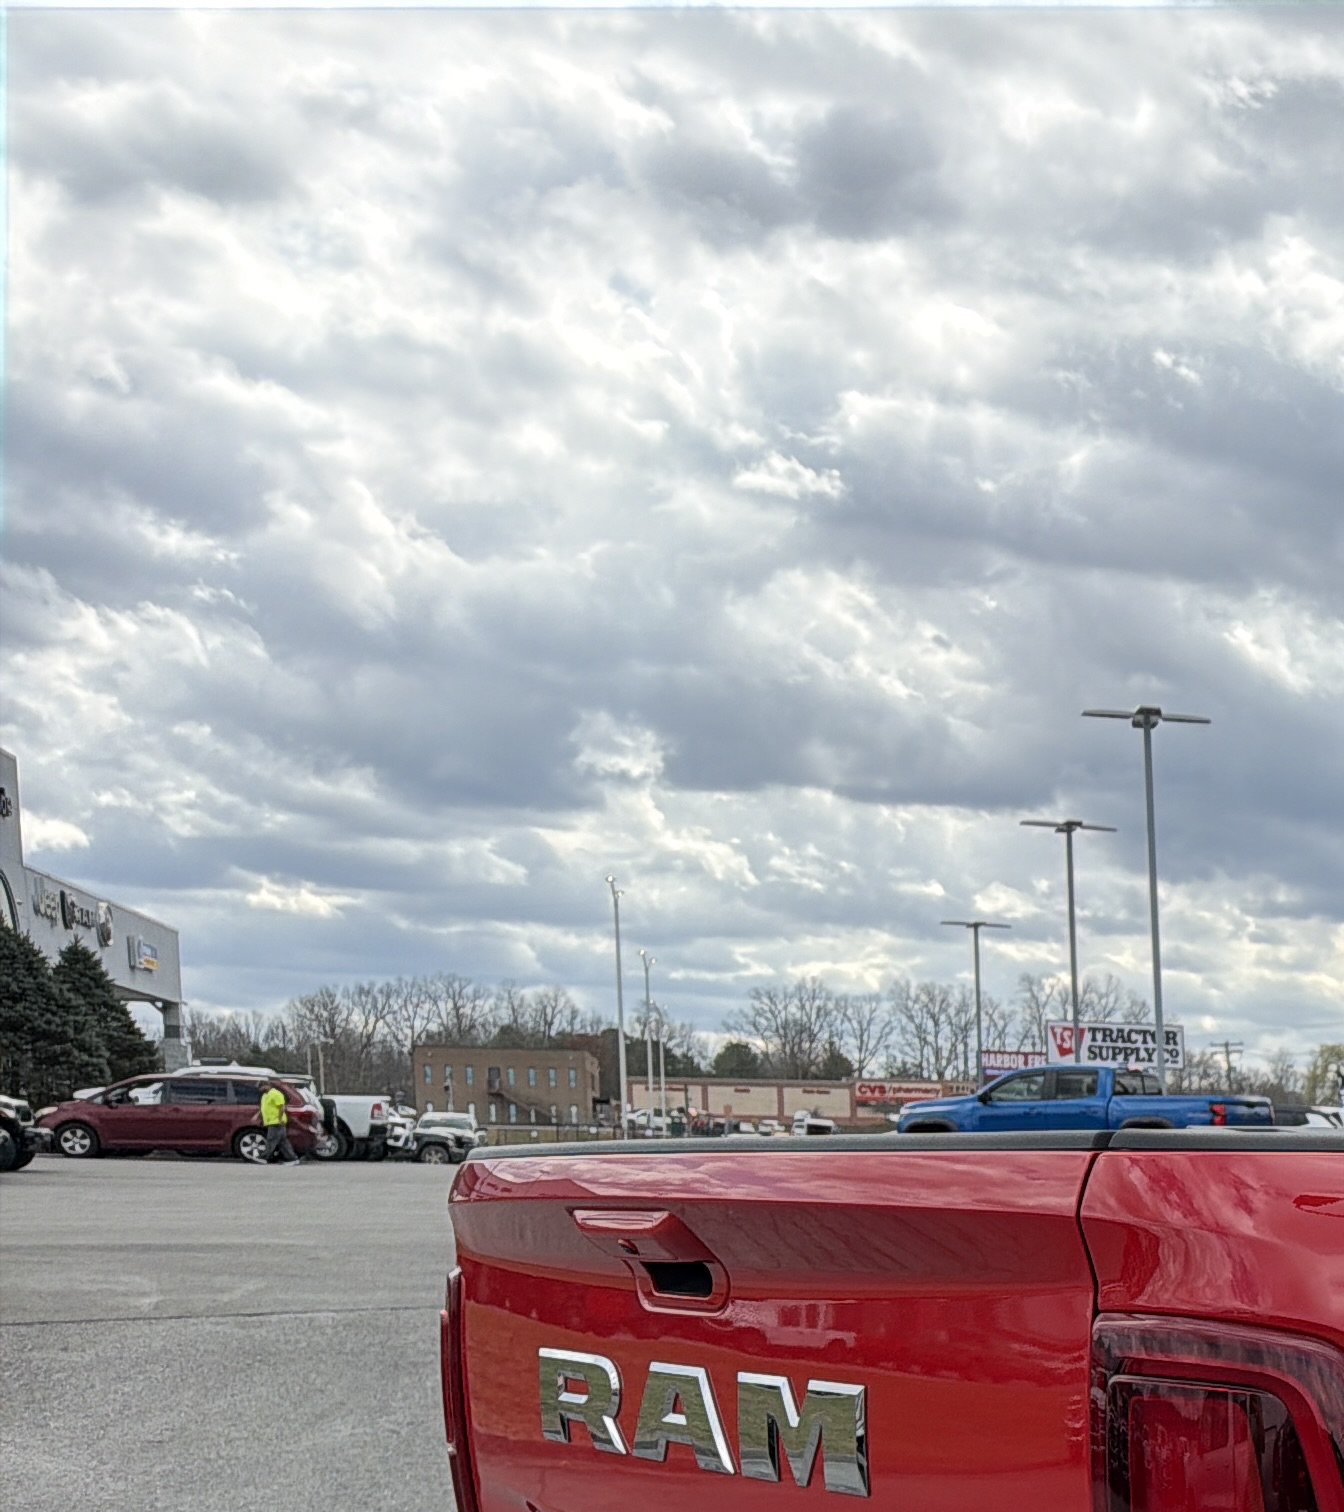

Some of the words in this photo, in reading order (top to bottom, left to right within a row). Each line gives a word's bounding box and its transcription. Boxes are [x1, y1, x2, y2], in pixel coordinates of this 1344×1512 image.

[981, 1052, 1025, 1069] HARBOR
[1087, 1045, 1156, 1064] SUPPLY
[538, 1347, 870, 1498] RAM
